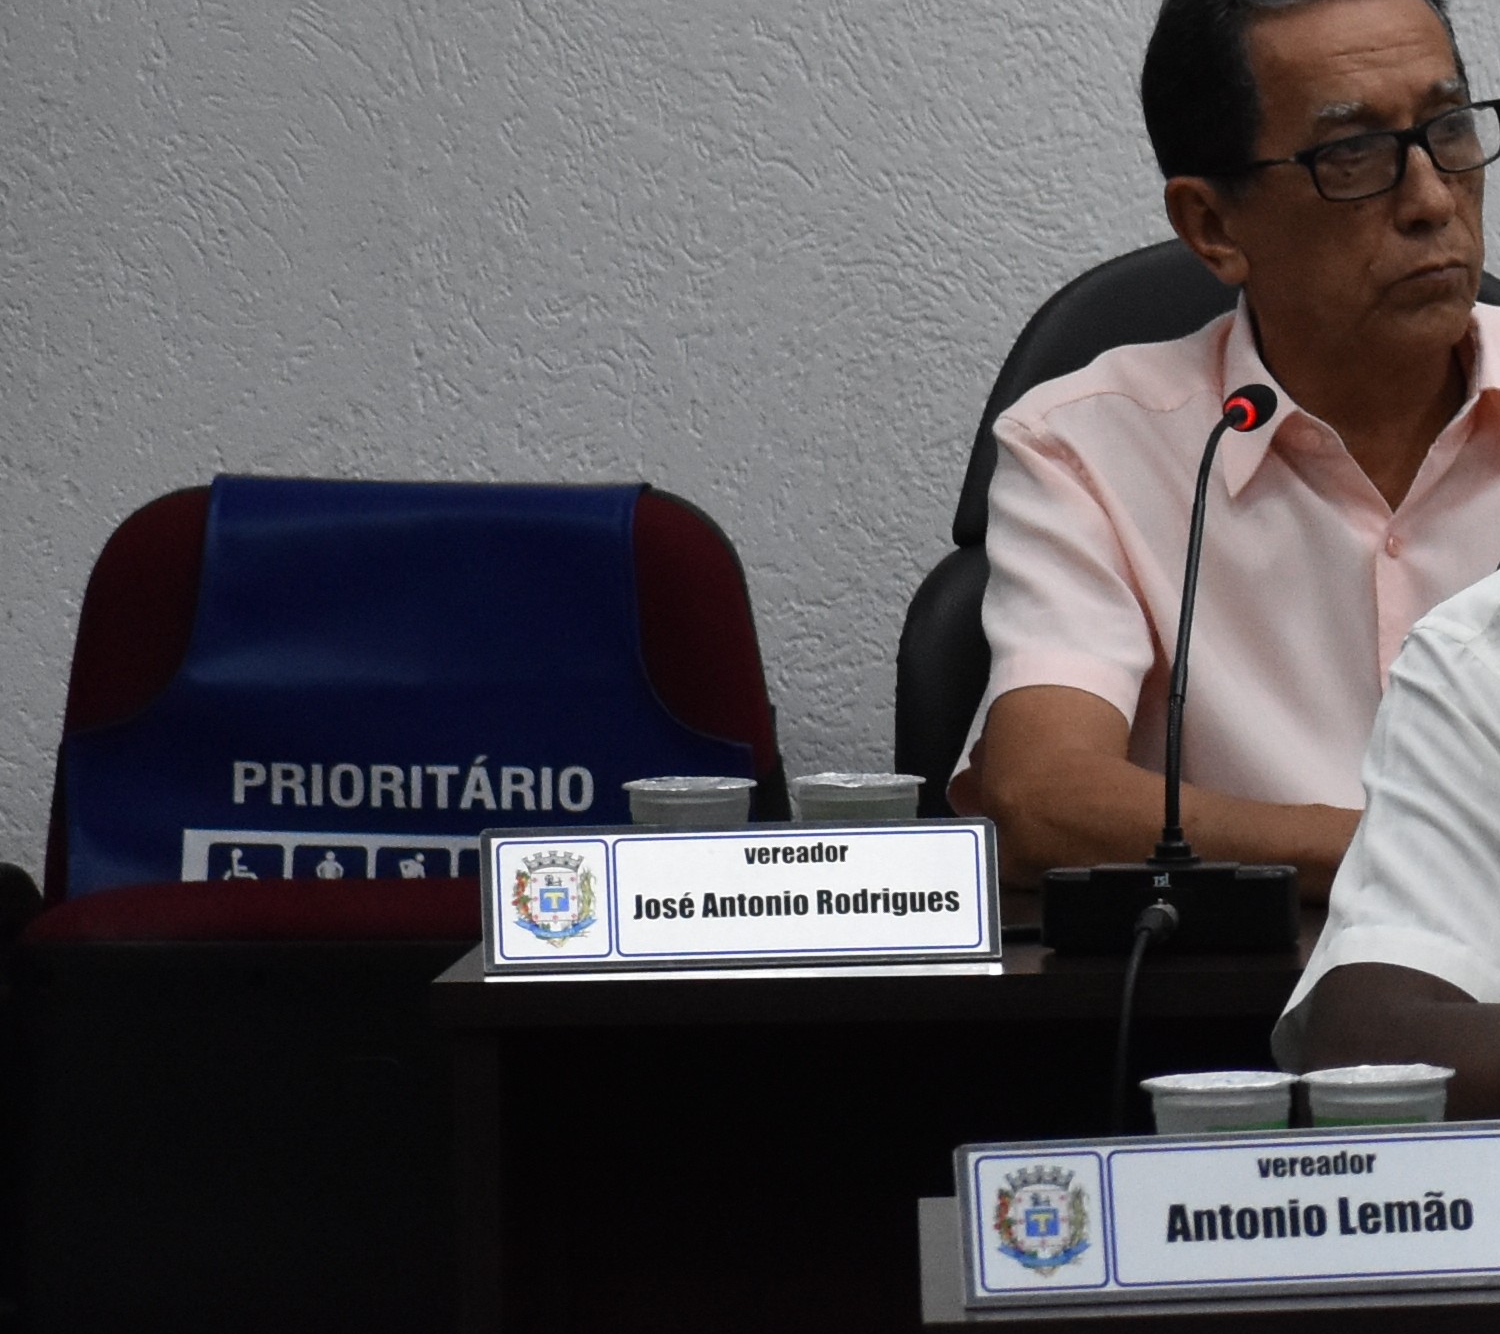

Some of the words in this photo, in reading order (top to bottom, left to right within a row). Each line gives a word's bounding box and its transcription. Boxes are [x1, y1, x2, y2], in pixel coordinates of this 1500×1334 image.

[232, 755, 595, 813] PRIORITÁRIO
[744, 839, 849, 866] vereador
[633, 890, 695, 921] José
[702, 889, 809, 919] Antonio
[817, 887, 961, 916] Rodrigues
[1257, 1151, 1377, 1178] vereador
[1167, 1199, 1328, 1244] Antonio
[1339, 1190, 1475, 1237] Lemão
